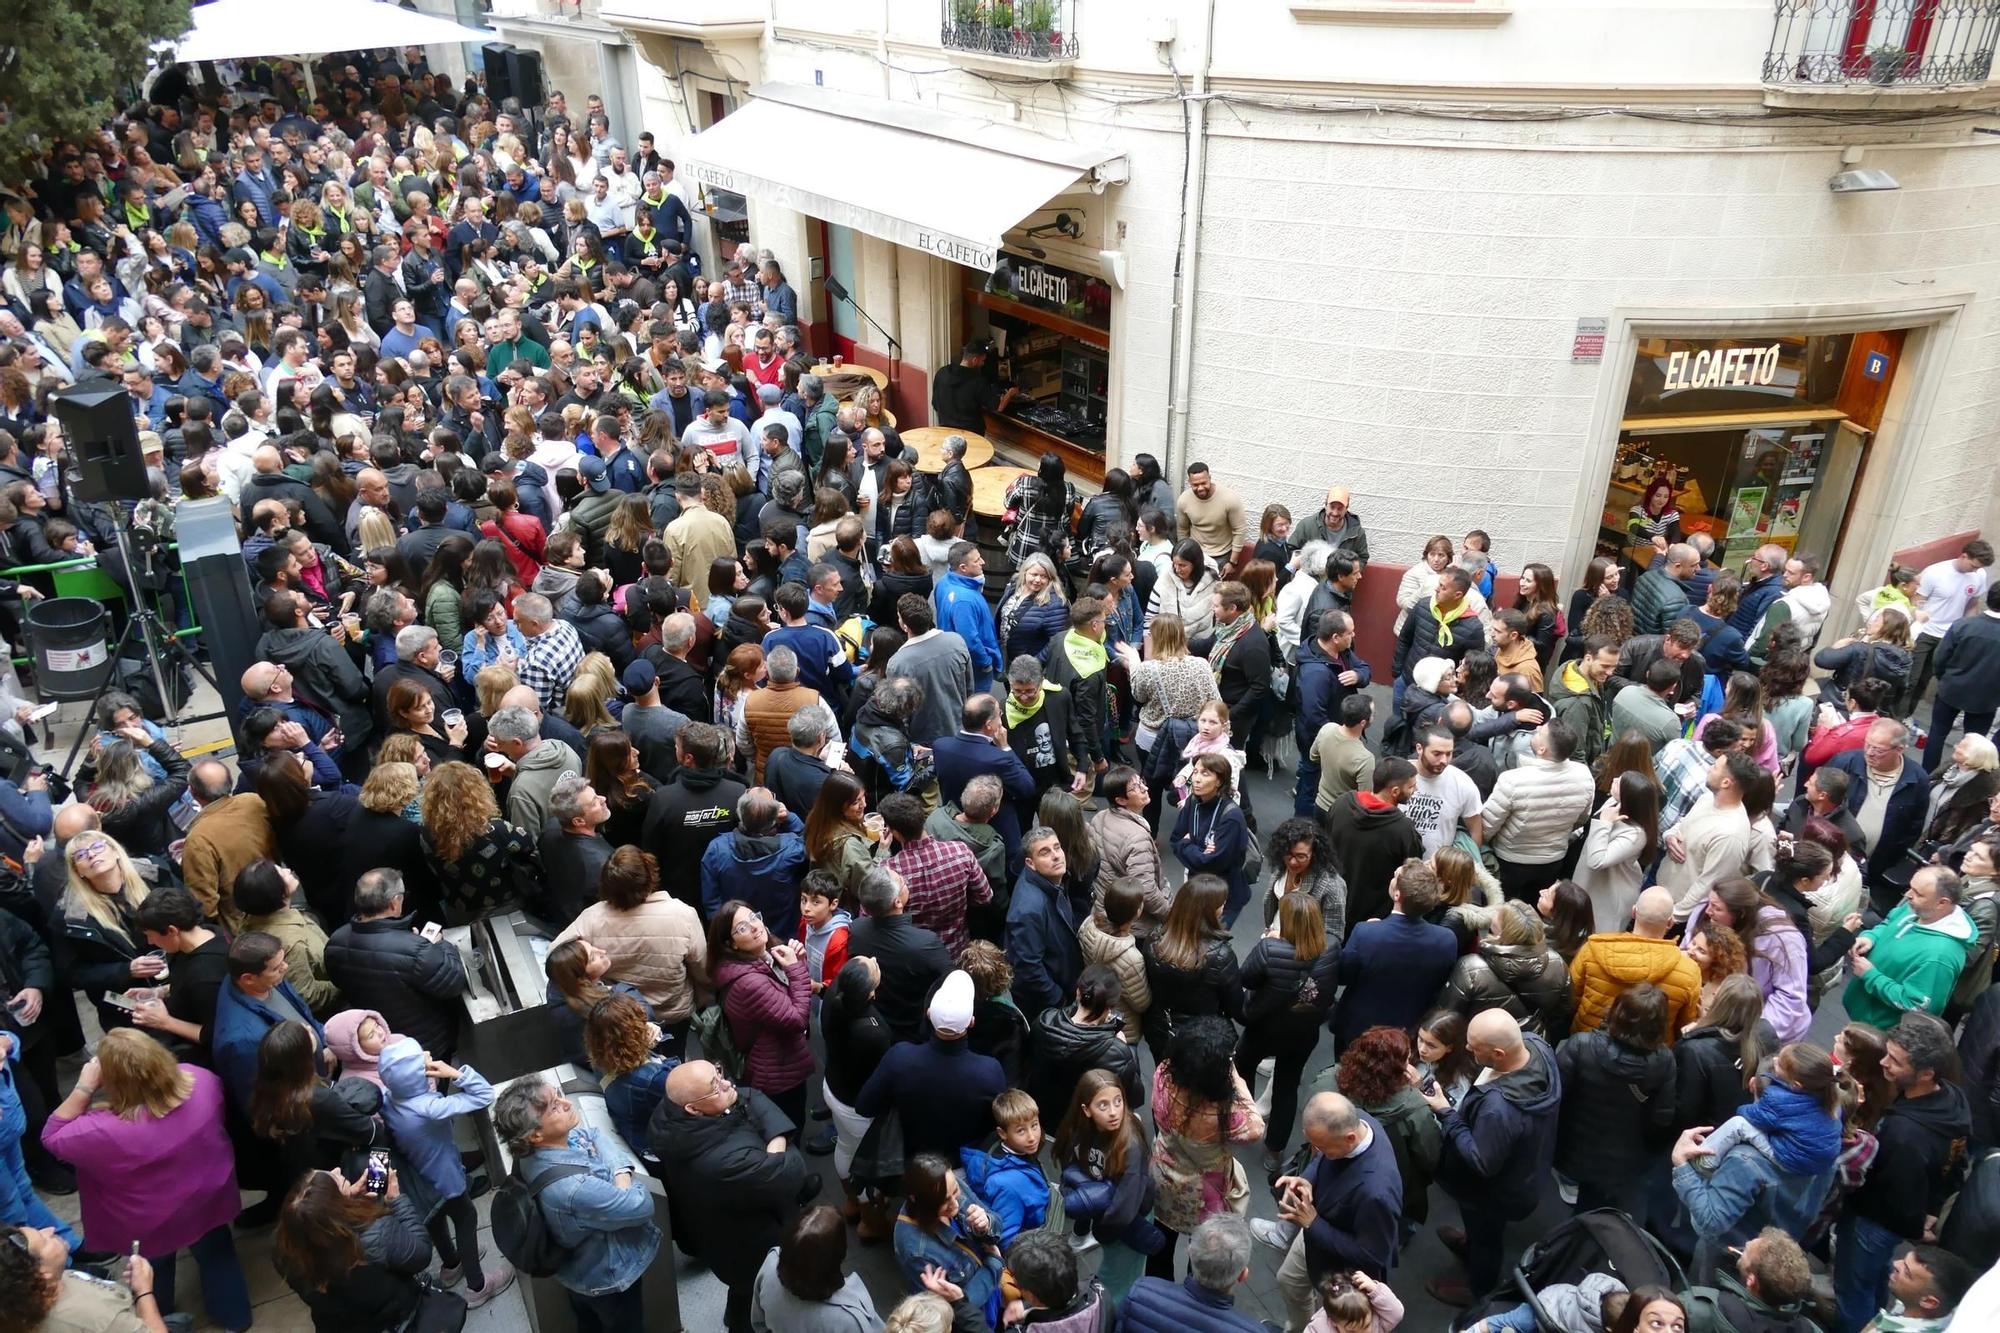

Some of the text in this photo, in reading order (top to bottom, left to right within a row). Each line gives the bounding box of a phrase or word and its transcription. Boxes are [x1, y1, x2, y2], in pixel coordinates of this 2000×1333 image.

[919, 232, 991, 269] EL CAFETÓ
[1871, 359, 1882, 374] B
